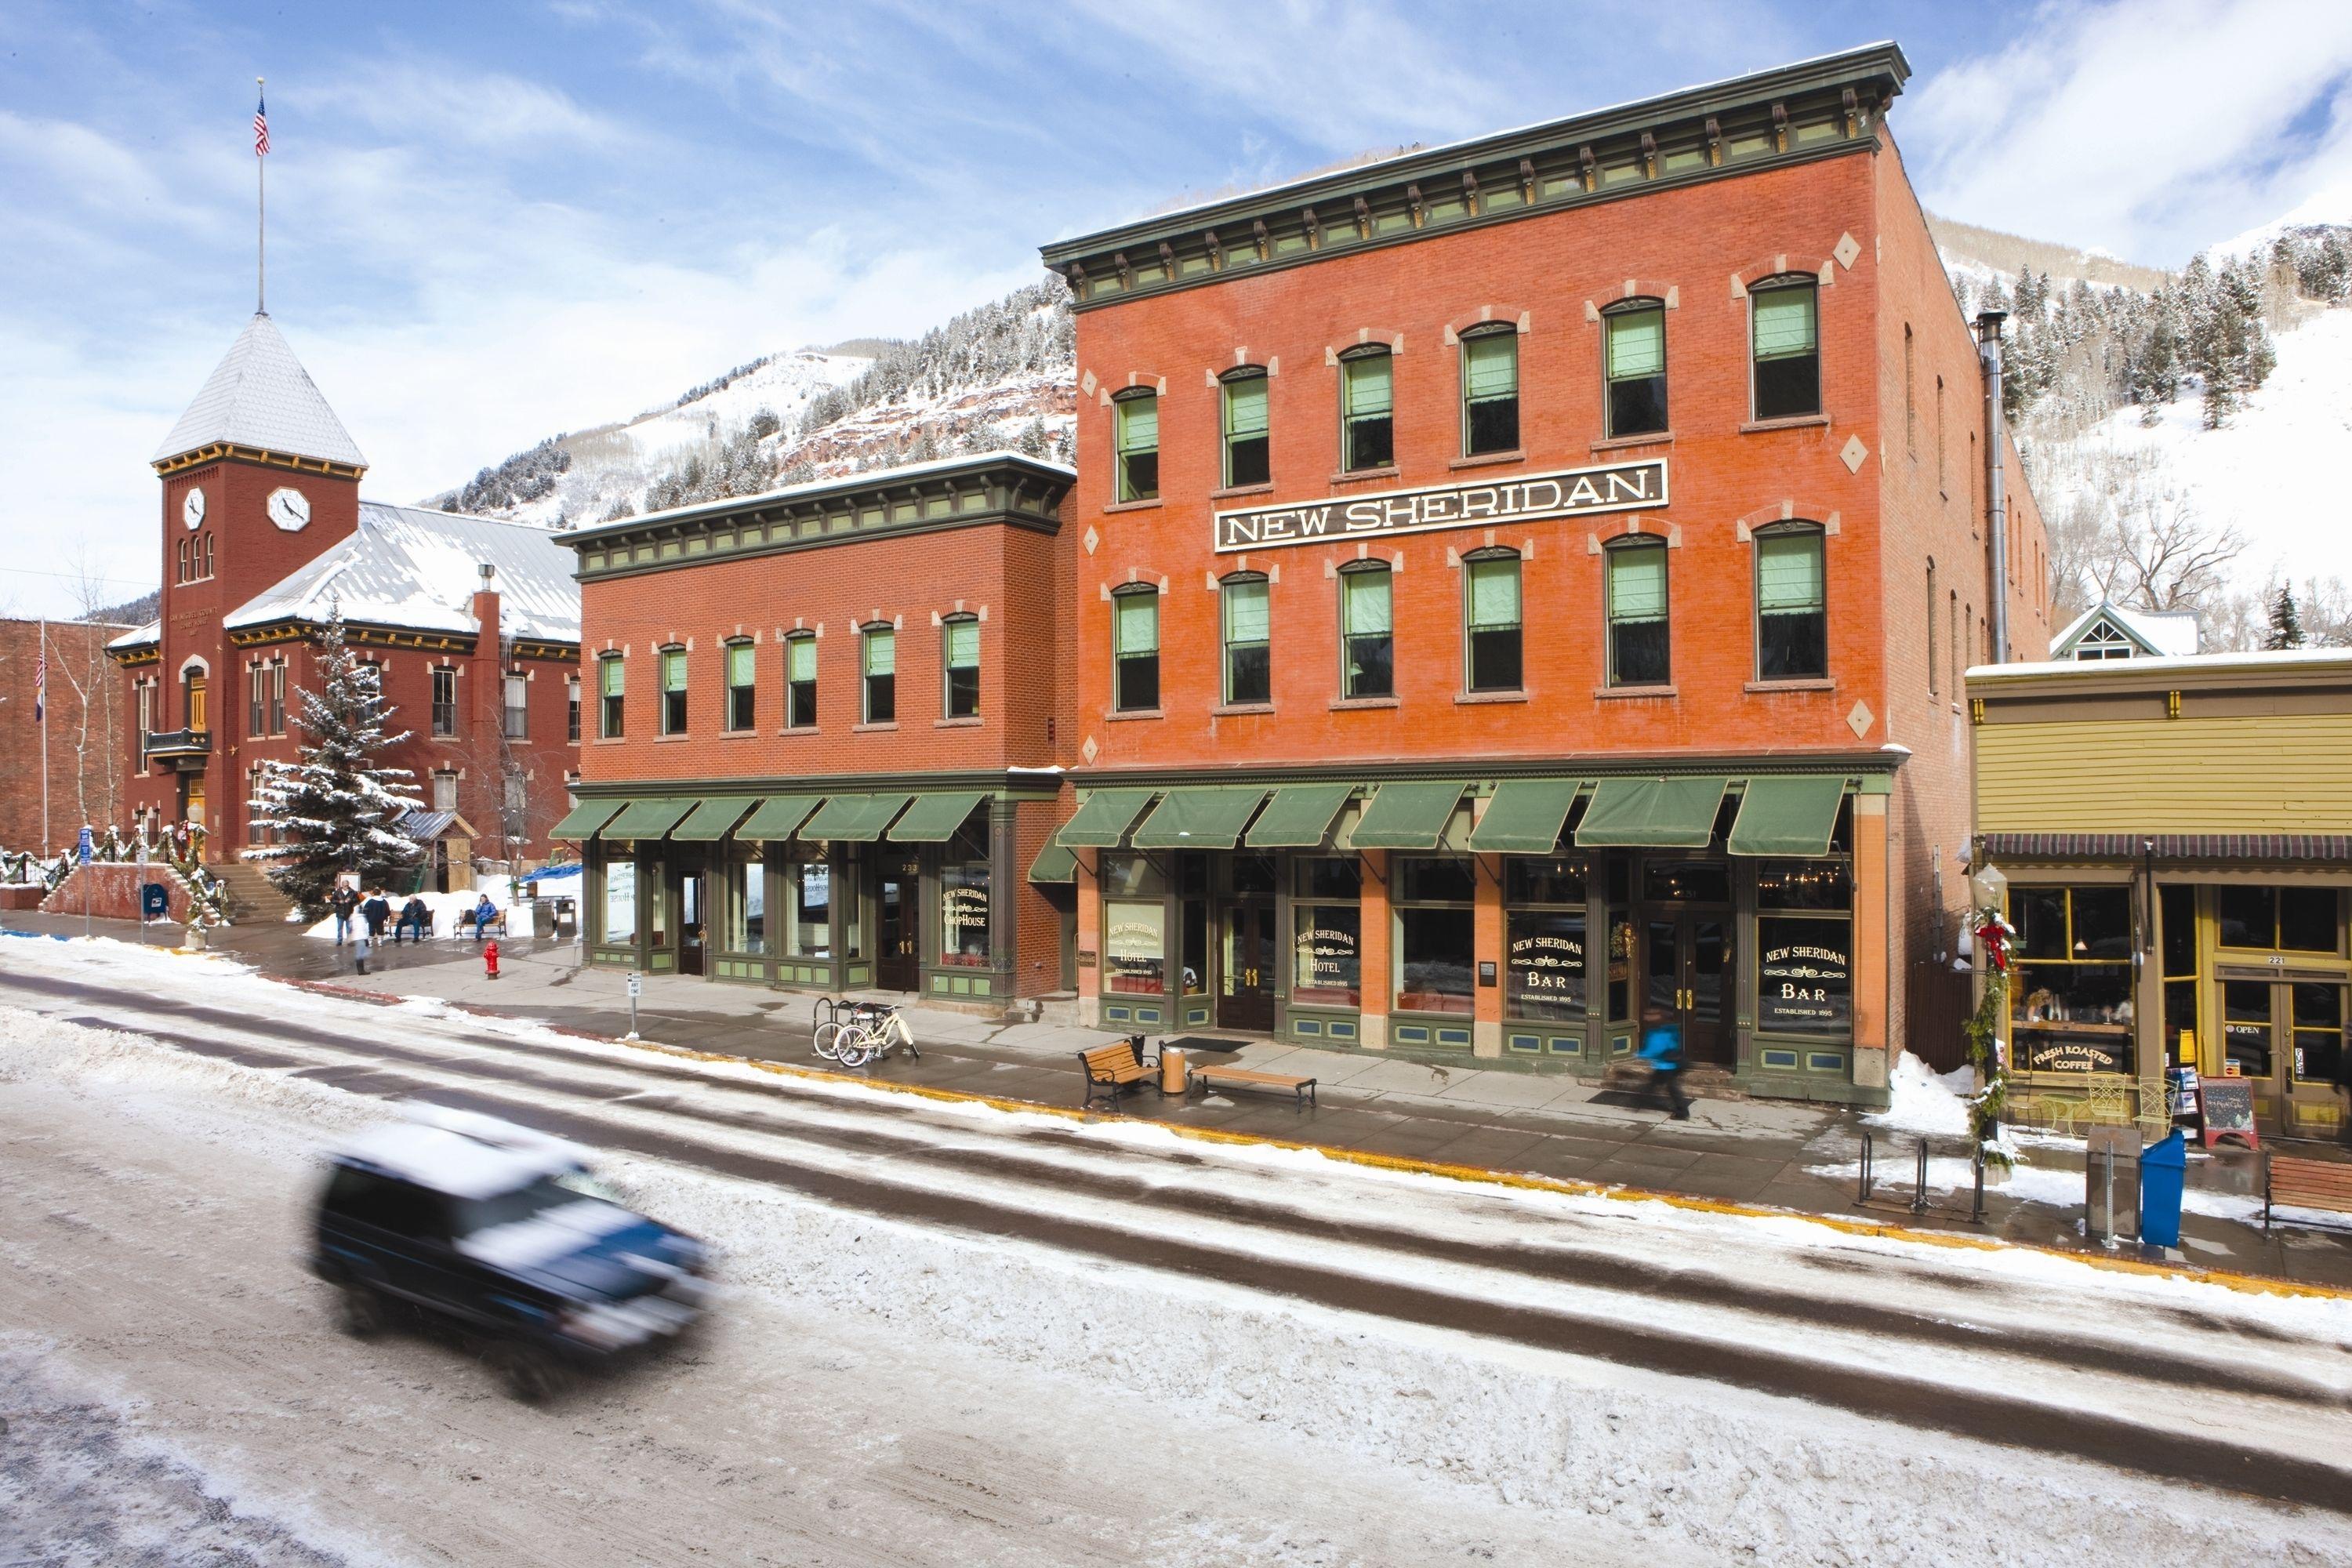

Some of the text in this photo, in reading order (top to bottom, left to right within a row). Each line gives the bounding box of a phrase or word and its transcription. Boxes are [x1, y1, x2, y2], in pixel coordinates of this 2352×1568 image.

[1227, 468, 1654, 545] NEW SHERIDAN.
[943, 888, 987, 902] NEW SHERIDAN
[944, 914, 985, 926] CHOPHOUSE
[1109, 922, 1158, 938] NEW SHERIDAN
[1298, 929, 1354, 946] NEW SHERIDAN
[1512, 937, 1582, 955] NEW SHERIDAN
[1120, 949, 1147, 963] HOTEL
[1766, 946, 1846, 966] NEW SHERIDAN
[1310, 958, 1341, 973] HOTEL
[1527, 971, 1566, 989] BAR
[1521, 993, 1558, 1002] ESTABLISHED
[1780, 983, 1826, 1002] BAR
[2236, 1025, 2259, 1034] OPEN
[2033, 1046, 2113, 1065] FRESH ROASTED
[2054, 1060, 2094, 1070] COFFEE
